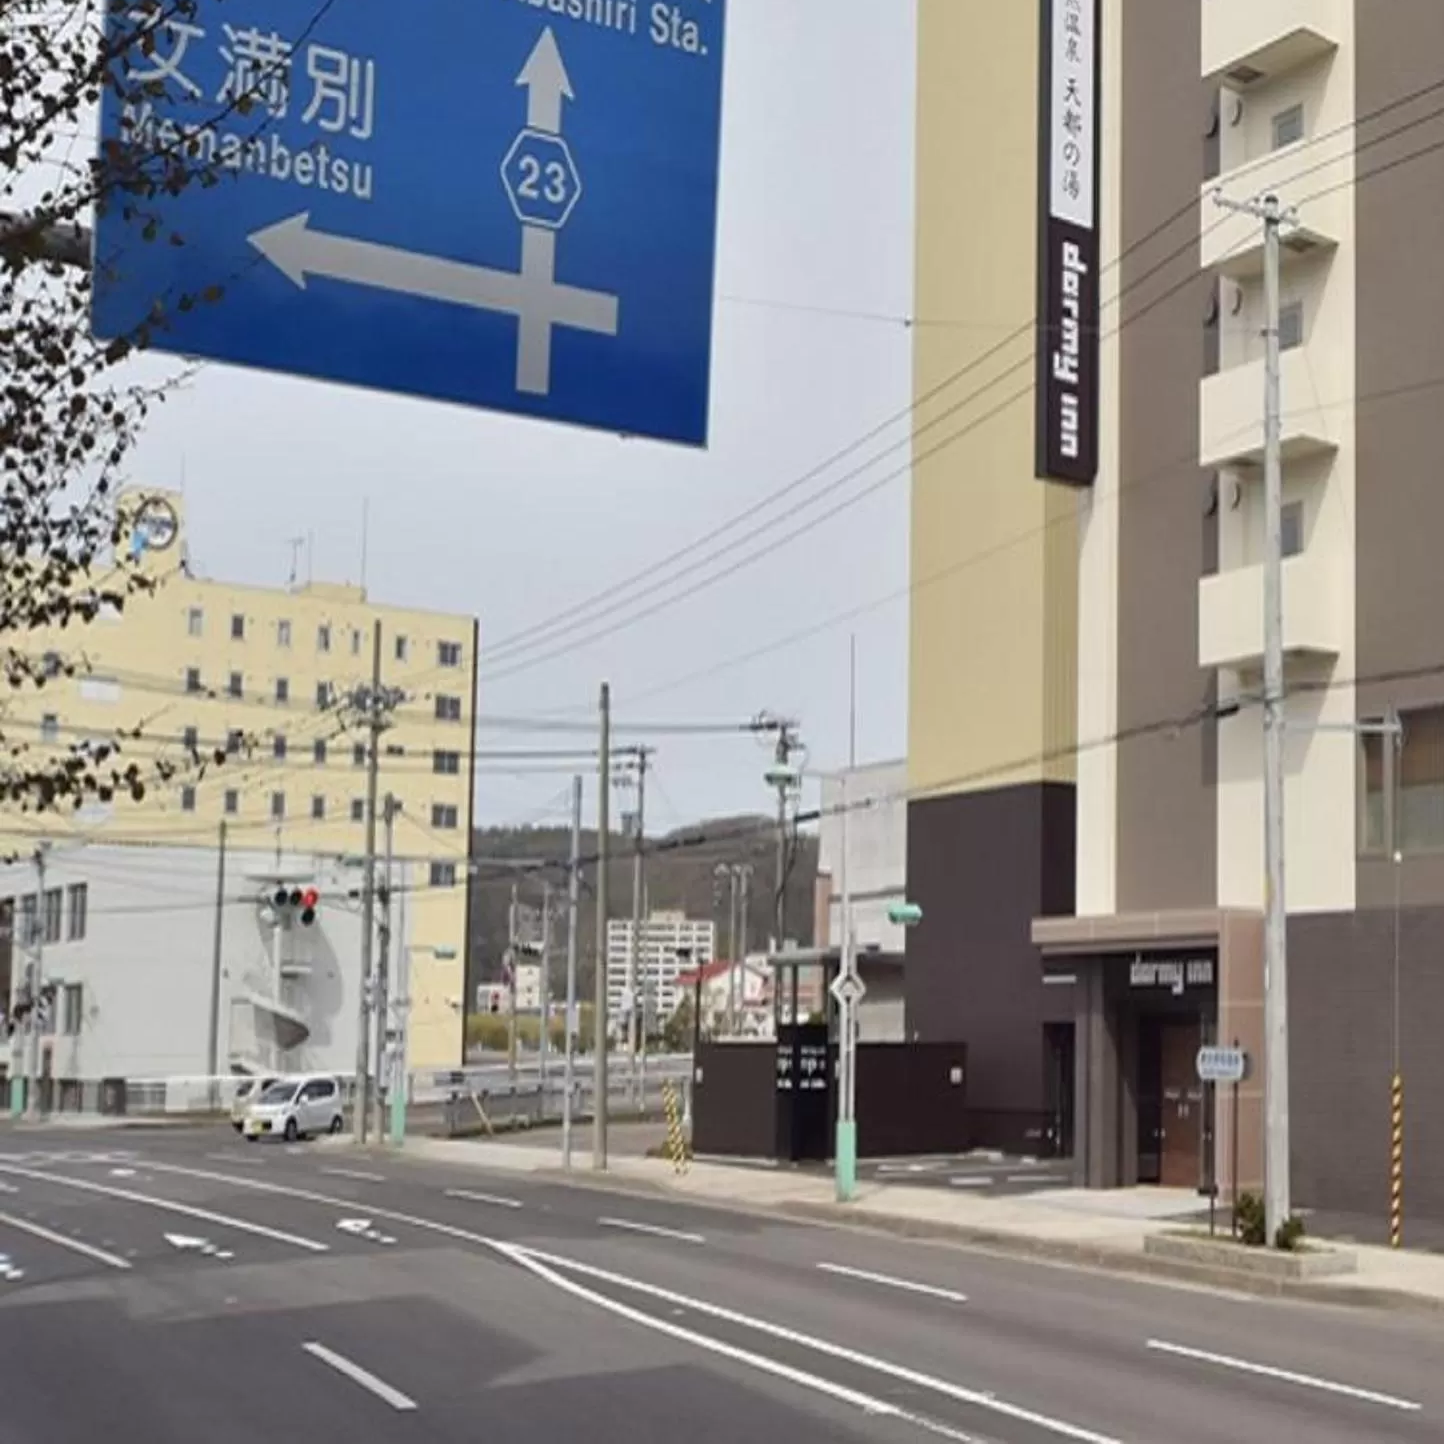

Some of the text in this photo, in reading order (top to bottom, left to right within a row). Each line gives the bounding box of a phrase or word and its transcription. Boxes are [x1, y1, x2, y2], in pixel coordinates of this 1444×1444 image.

[650, 1, 708, 56] Sta.
[126, 5, 375, 140] 女満別
[517, 154, 566, 205] 23
[1053, 239, 1089, 459] dormy inn
[1129, 950, 1213, 996] dormy inn
